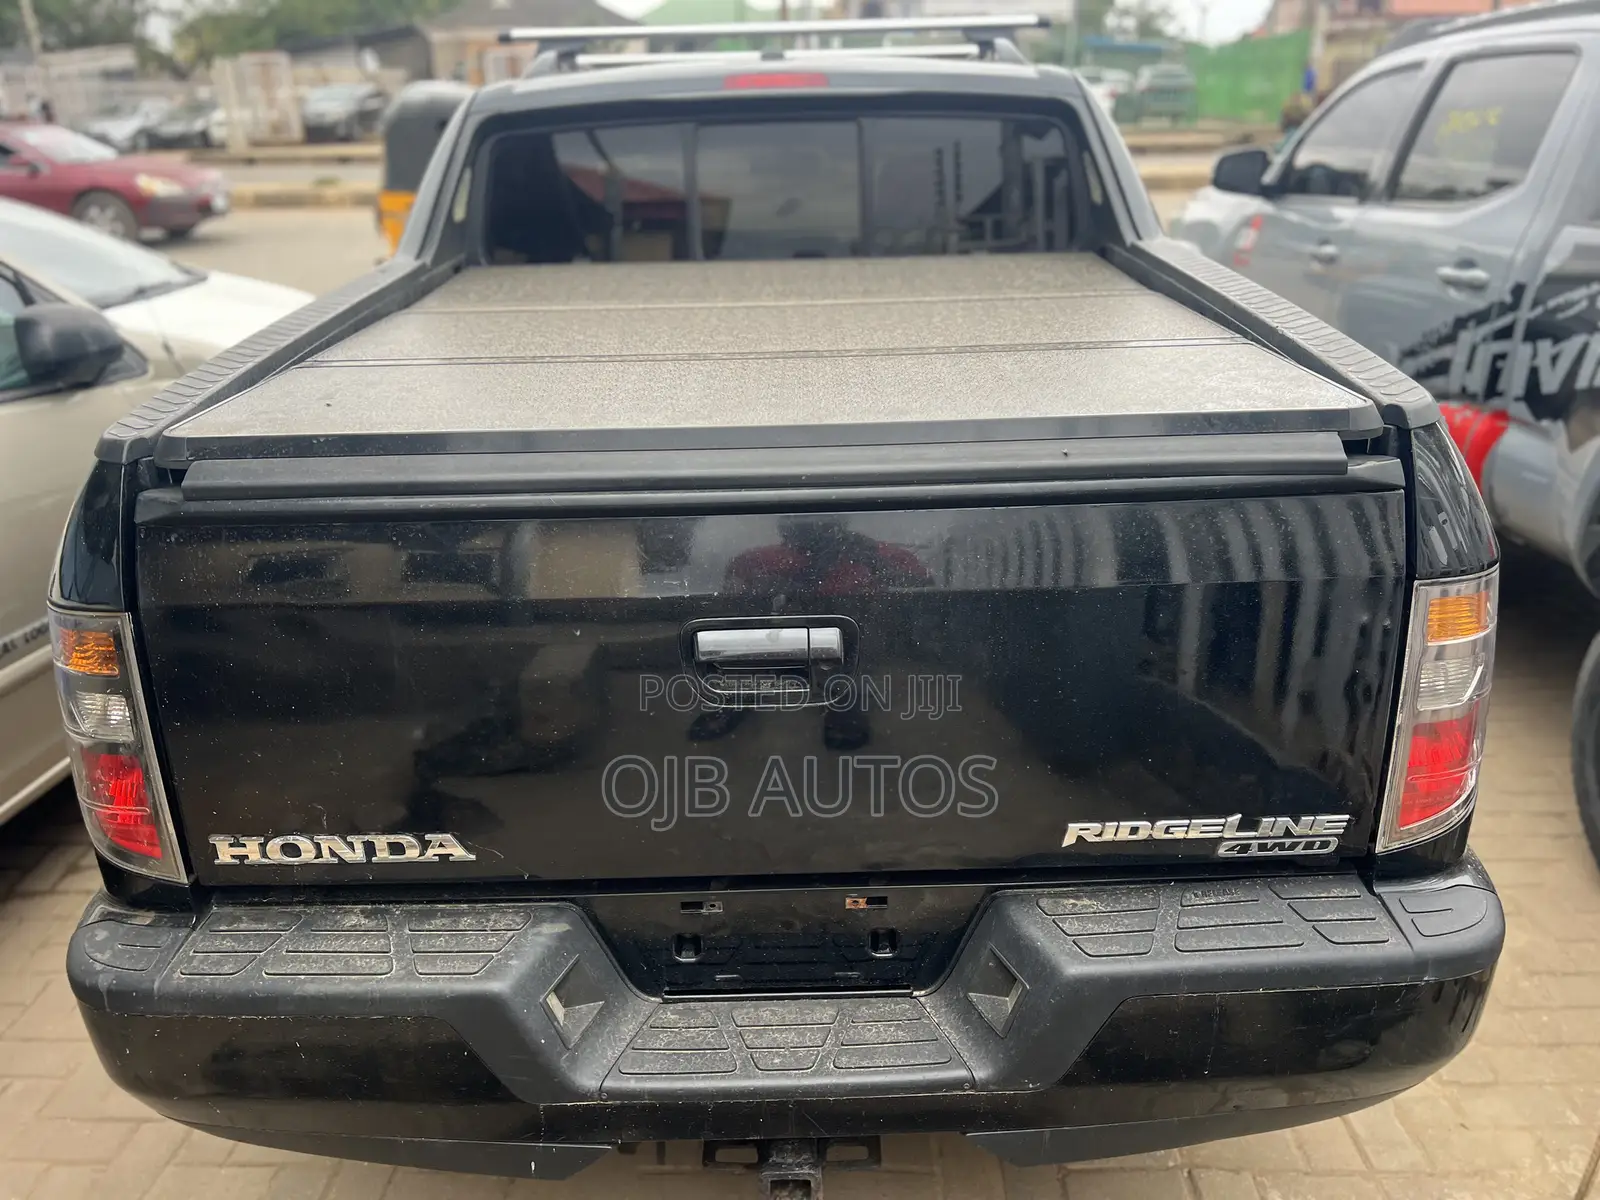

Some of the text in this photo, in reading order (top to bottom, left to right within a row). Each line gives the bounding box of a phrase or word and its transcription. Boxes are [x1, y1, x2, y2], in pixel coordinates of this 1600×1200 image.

[1061, 813, 1351, 848] RIDGELINE
[208, 833, 477, 865] HONDA
[1223, 838, 1331, 856] 4WD
